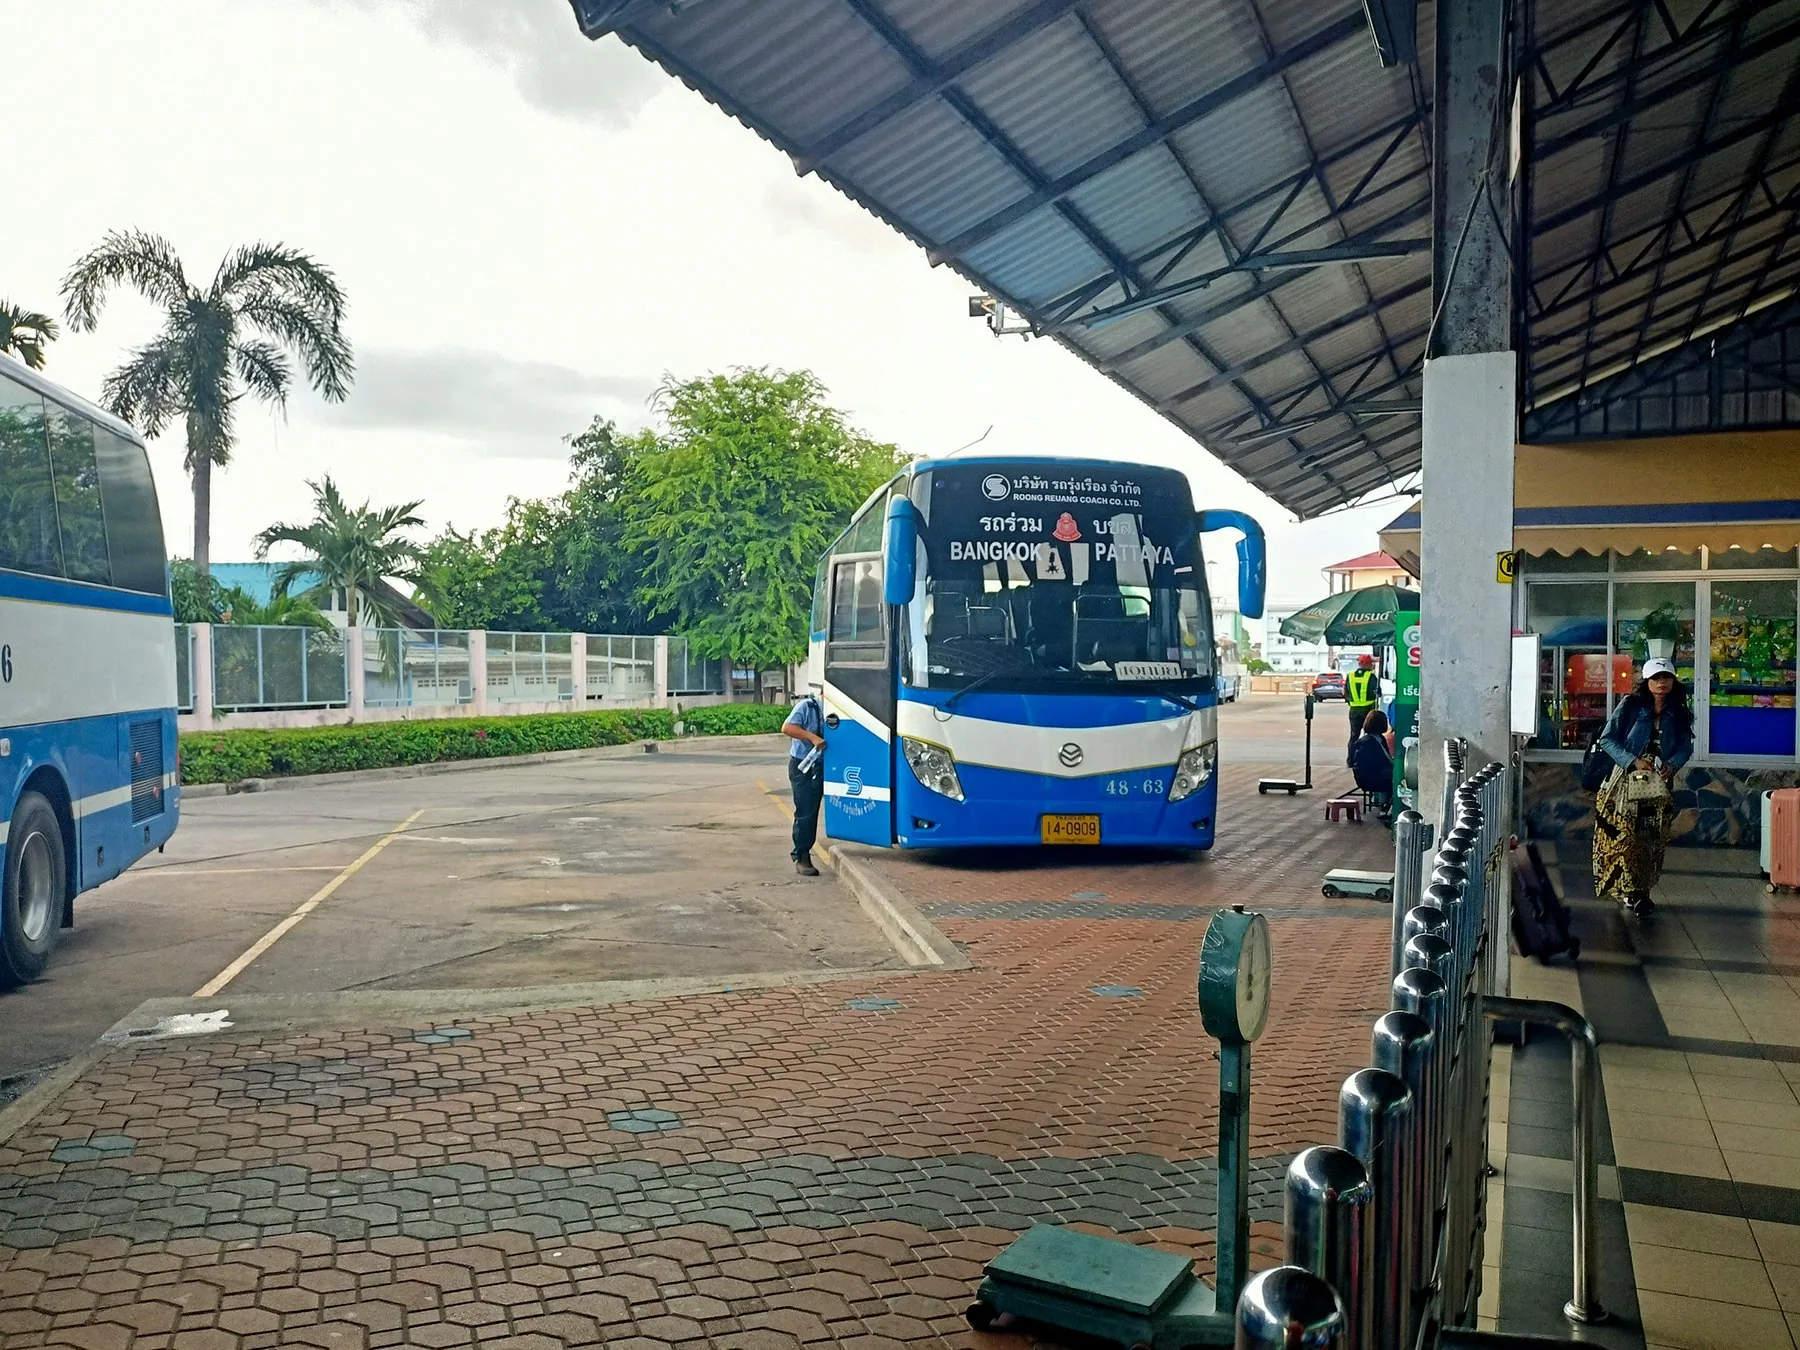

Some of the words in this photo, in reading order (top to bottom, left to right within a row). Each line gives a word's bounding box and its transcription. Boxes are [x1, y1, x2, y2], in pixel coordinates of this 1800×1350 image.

[1013, 475, 1048, 490] บริษัท
[1051, 477, 1107, 495] รถรุ่งเรือง
[1109, 480, 1142, 495] จำกัด
[1013, 493, 1043, 502] ROONG
[1044, 494, 1078, 503] REUANG
[1079, 496, 1108, 505] COACH
[1109, 498, 1123, 506] CO.
[1124, 499, 1142, 507] LTD.
[979, 512, 1043, 532] รถร่วม
[950, 541, 1042, 562] BANGKOK
[1095, 542, 1175, 566] PATTAYA
[1047, 821, 1097, 836] 14-0909
